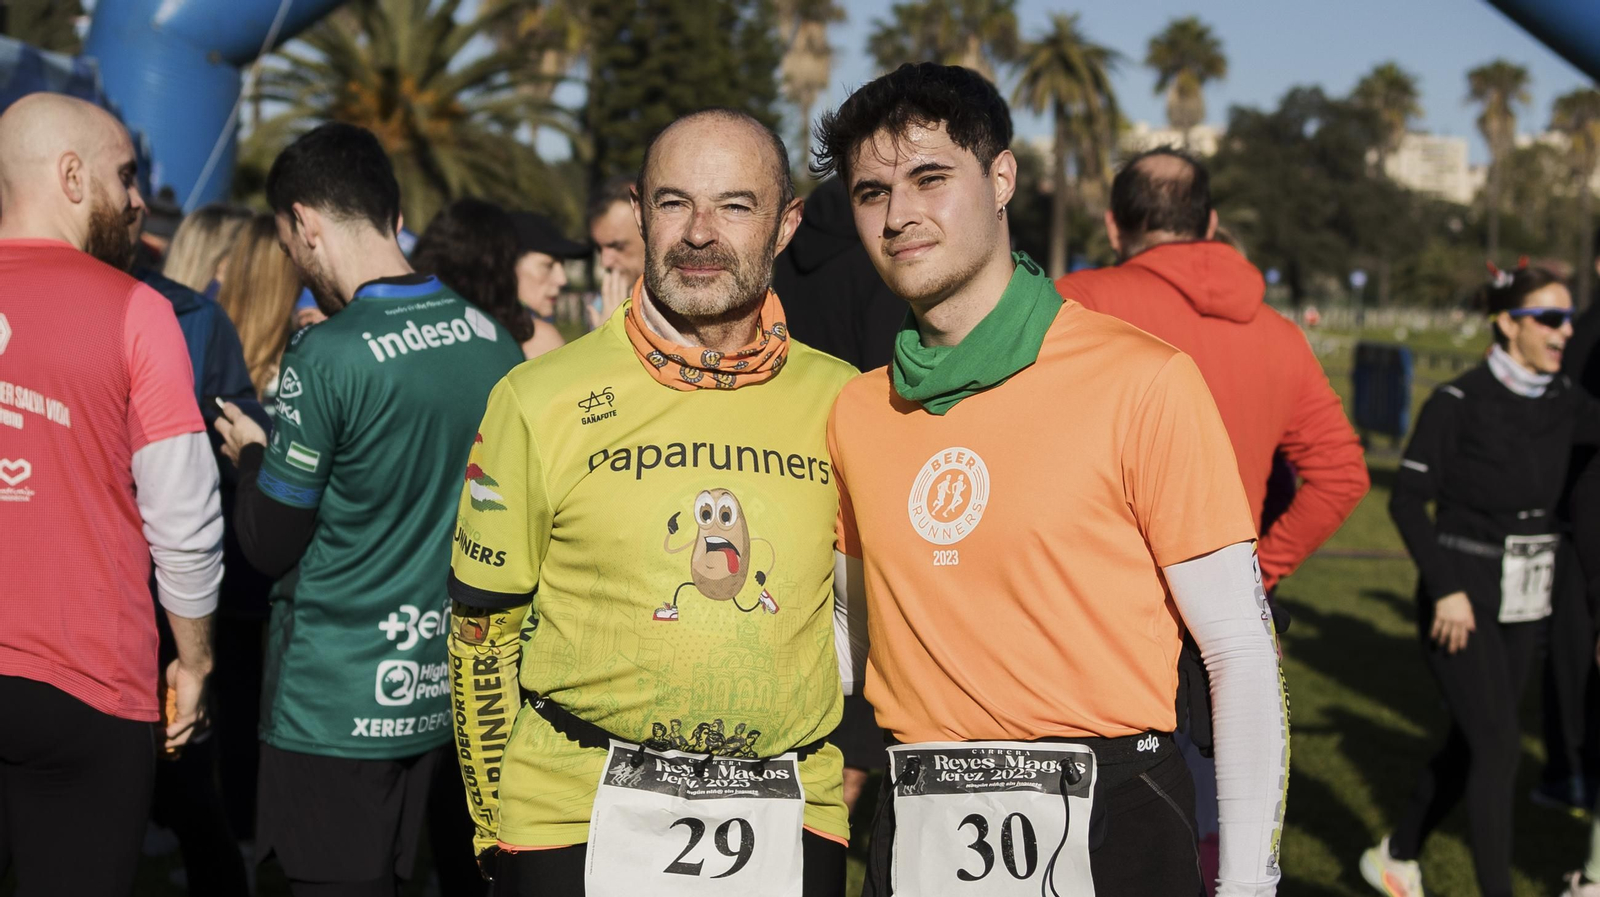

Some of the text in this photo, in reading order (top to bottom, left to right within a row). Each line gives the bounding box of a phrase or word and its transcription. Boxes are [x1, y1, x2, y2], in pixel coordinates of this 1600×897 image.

[361, 318, 471, 363] indeso
[15, 385, 47, 417] SALVA
[46, 396, 71, 428] VIDA
[581, 409, 617, 425] GAÑAFOTE
[930, 451, 977, 473] BEER
[912, 502, 983, 540] RUNNERS
[932, 549, 959, 566] 2023
[350, 717, 416, 738] XEREZ
[453, 656, 485, 807] CLUB DEPORTIVO
[971, 748, 1031, 756] CARRERA
[1136, 734, 1160, 753] edp
[655, 758, 709, 777] Reys
[933, 754, 1086, 774] Reyes Mags
[705, 778, 751, 788] 2025
[936, 767, 1037, 782] Jerez 2025
[662, 816, 756, 879] 29
[956, 812, 1039, 882] 30
